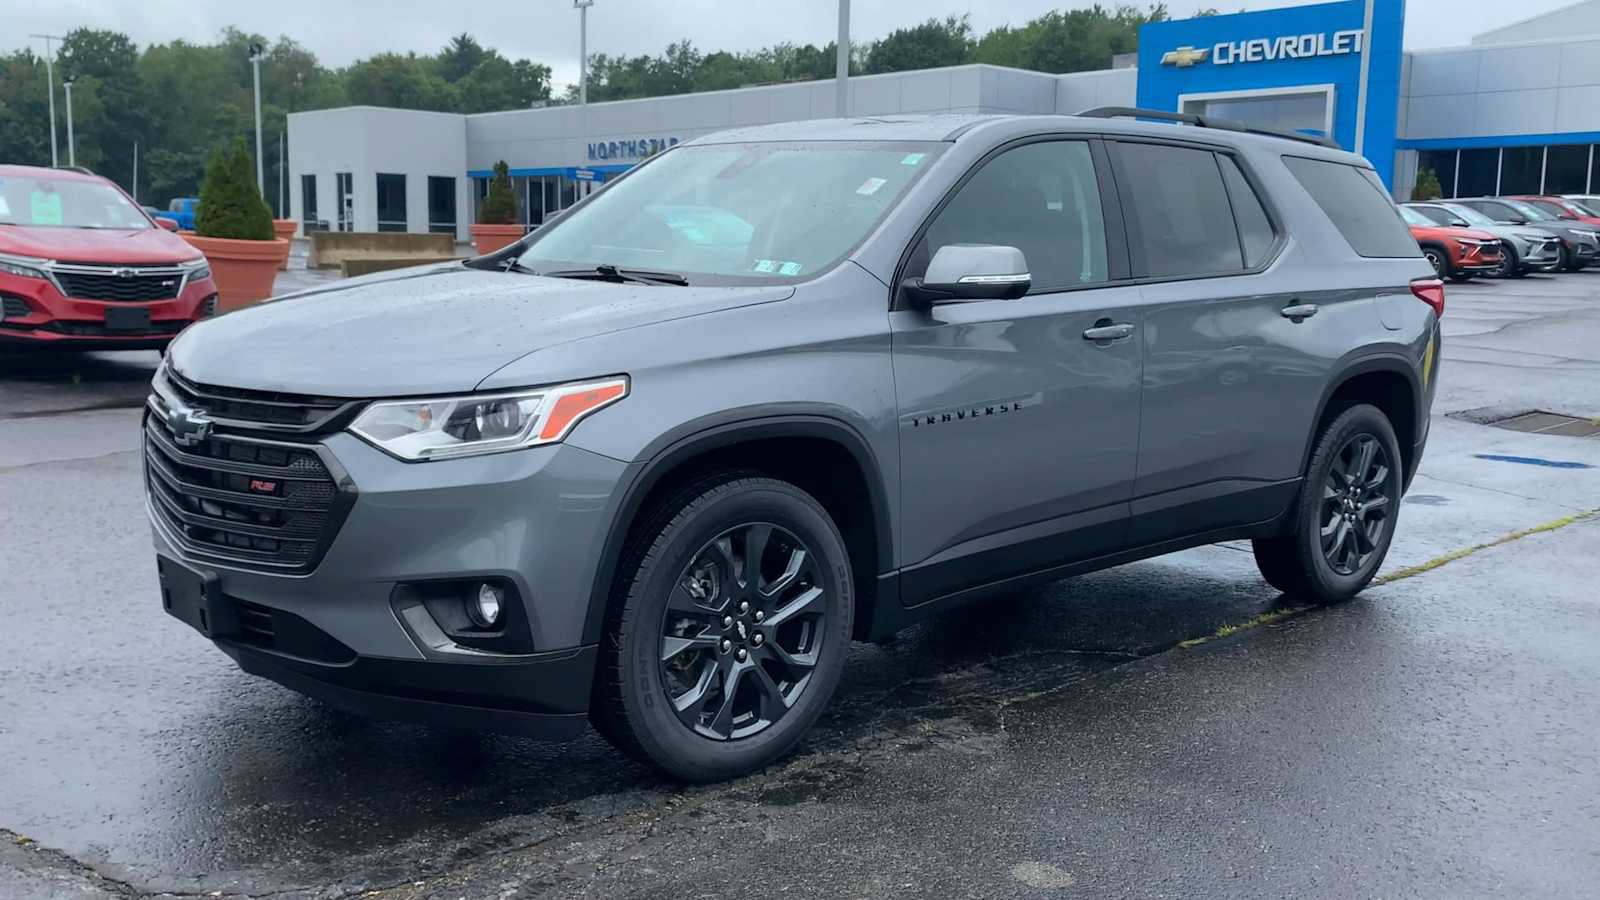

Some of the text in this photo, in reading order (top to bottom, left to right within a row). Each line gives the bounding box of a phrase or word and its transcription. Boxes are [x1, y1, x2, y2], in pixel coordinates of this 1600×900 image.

[1212, 29, 1364, 65] CHEVROLET
[911, 402, 1022, 428] TRAVERSE
[250, 480, 276, 491] RS
